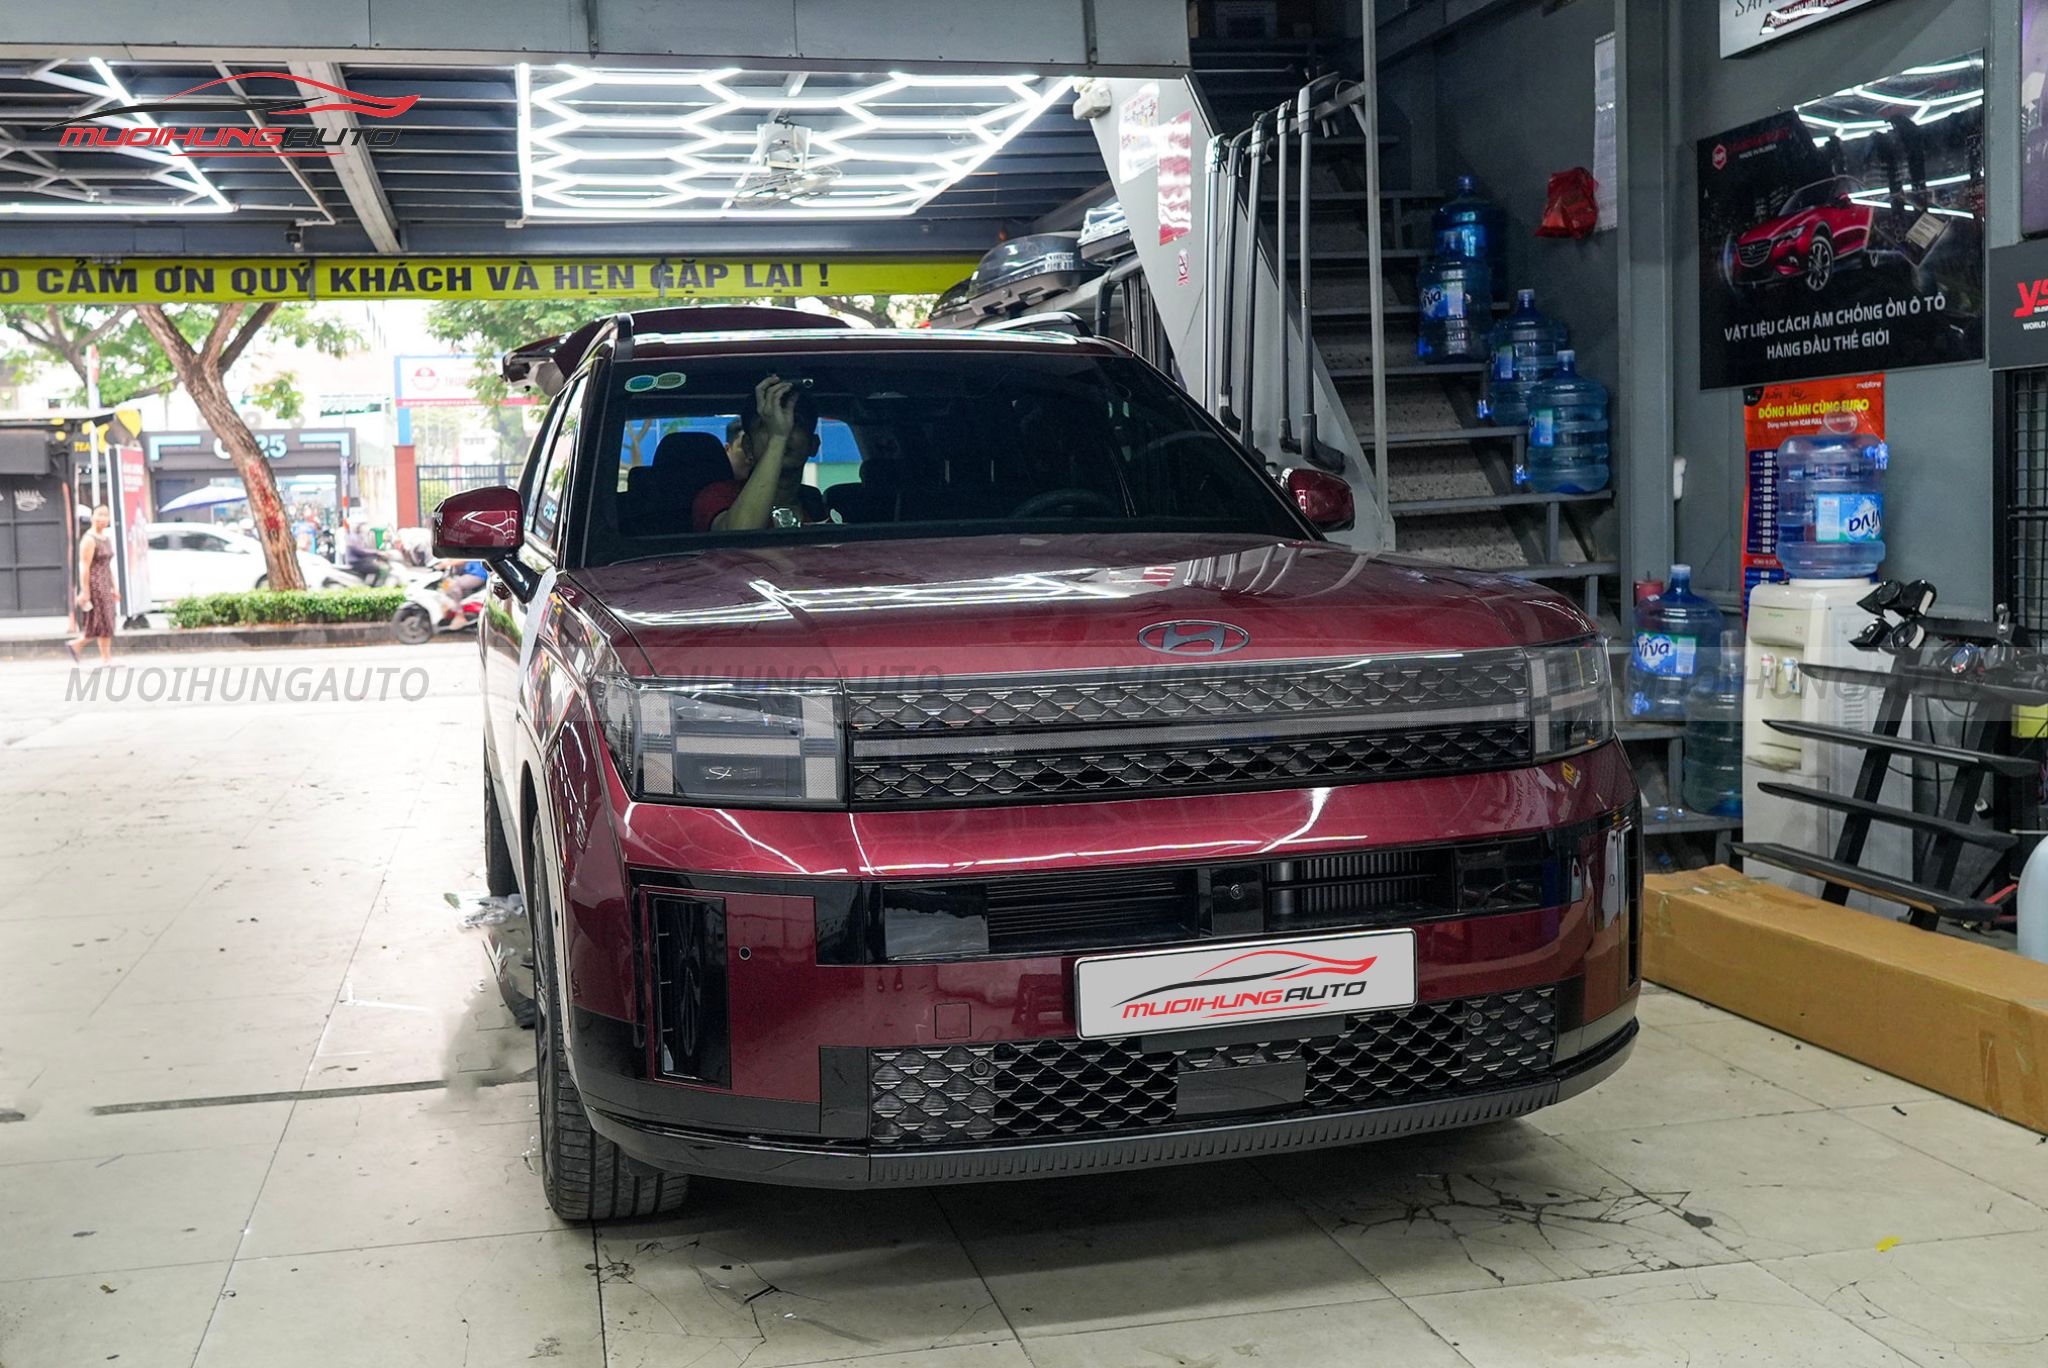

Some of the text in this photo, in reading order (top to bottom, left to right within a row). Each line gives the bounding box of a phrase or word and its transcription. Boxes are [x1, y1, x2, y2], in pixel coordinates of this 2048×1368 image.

[37, 258, 138, 294] CẢM
[154, 264, 214, 293] ƠN
[231, 262, 313, 296] QUÝ
[331, 262, 471, 293] KHÁCH
[486, 261, 539, 291] VÀ
[554, 265, 634, 295] HẸN
[650, 258, 728, 294] GẶP
[744, 263, 803, 293] LẠI
[1724, 291, 1946, 343] VẬT LIỆU CÁCH ÂM CHỐNG ỒN Ô TÔ
[1767, 328, 1890, 360] HÀNG ĐẦU THẾ GIỚI
[1758, 398, 1870, 419] ĐỒNG HÀNH CÙNG EURO
[213, 433, 288, 460] 25
